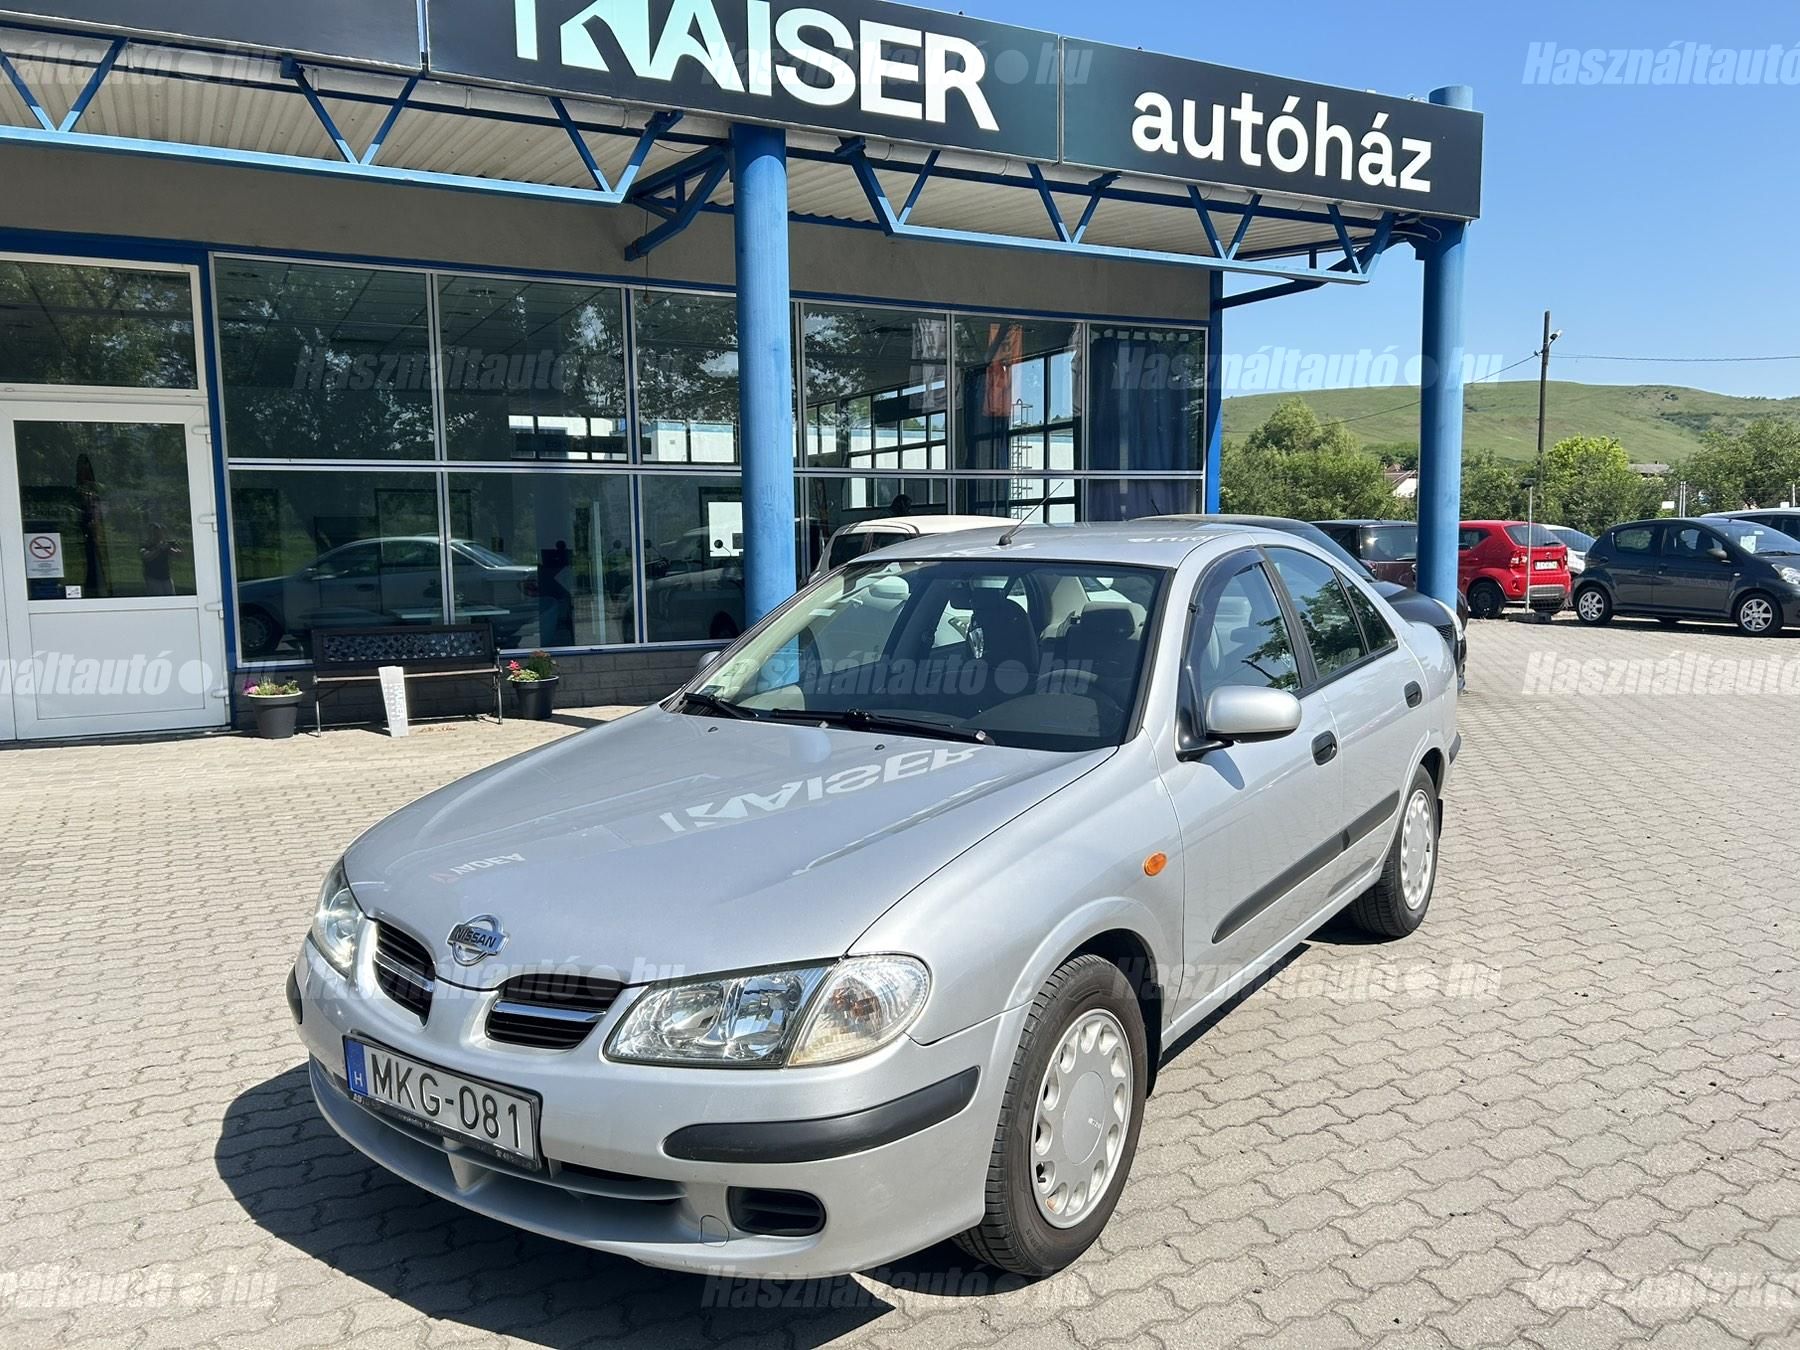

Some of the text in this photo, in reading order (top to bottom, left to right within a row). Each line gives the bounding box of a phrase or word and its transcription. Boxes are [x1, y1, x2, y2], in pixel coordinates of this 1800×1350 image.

[516, 0, 1432, 193] KAISER autóház
[454, 926, 497, 949] NISSAN
[354, 1071, 363, 1087] H
[370, 1052, 521, 1149] MKG-081
